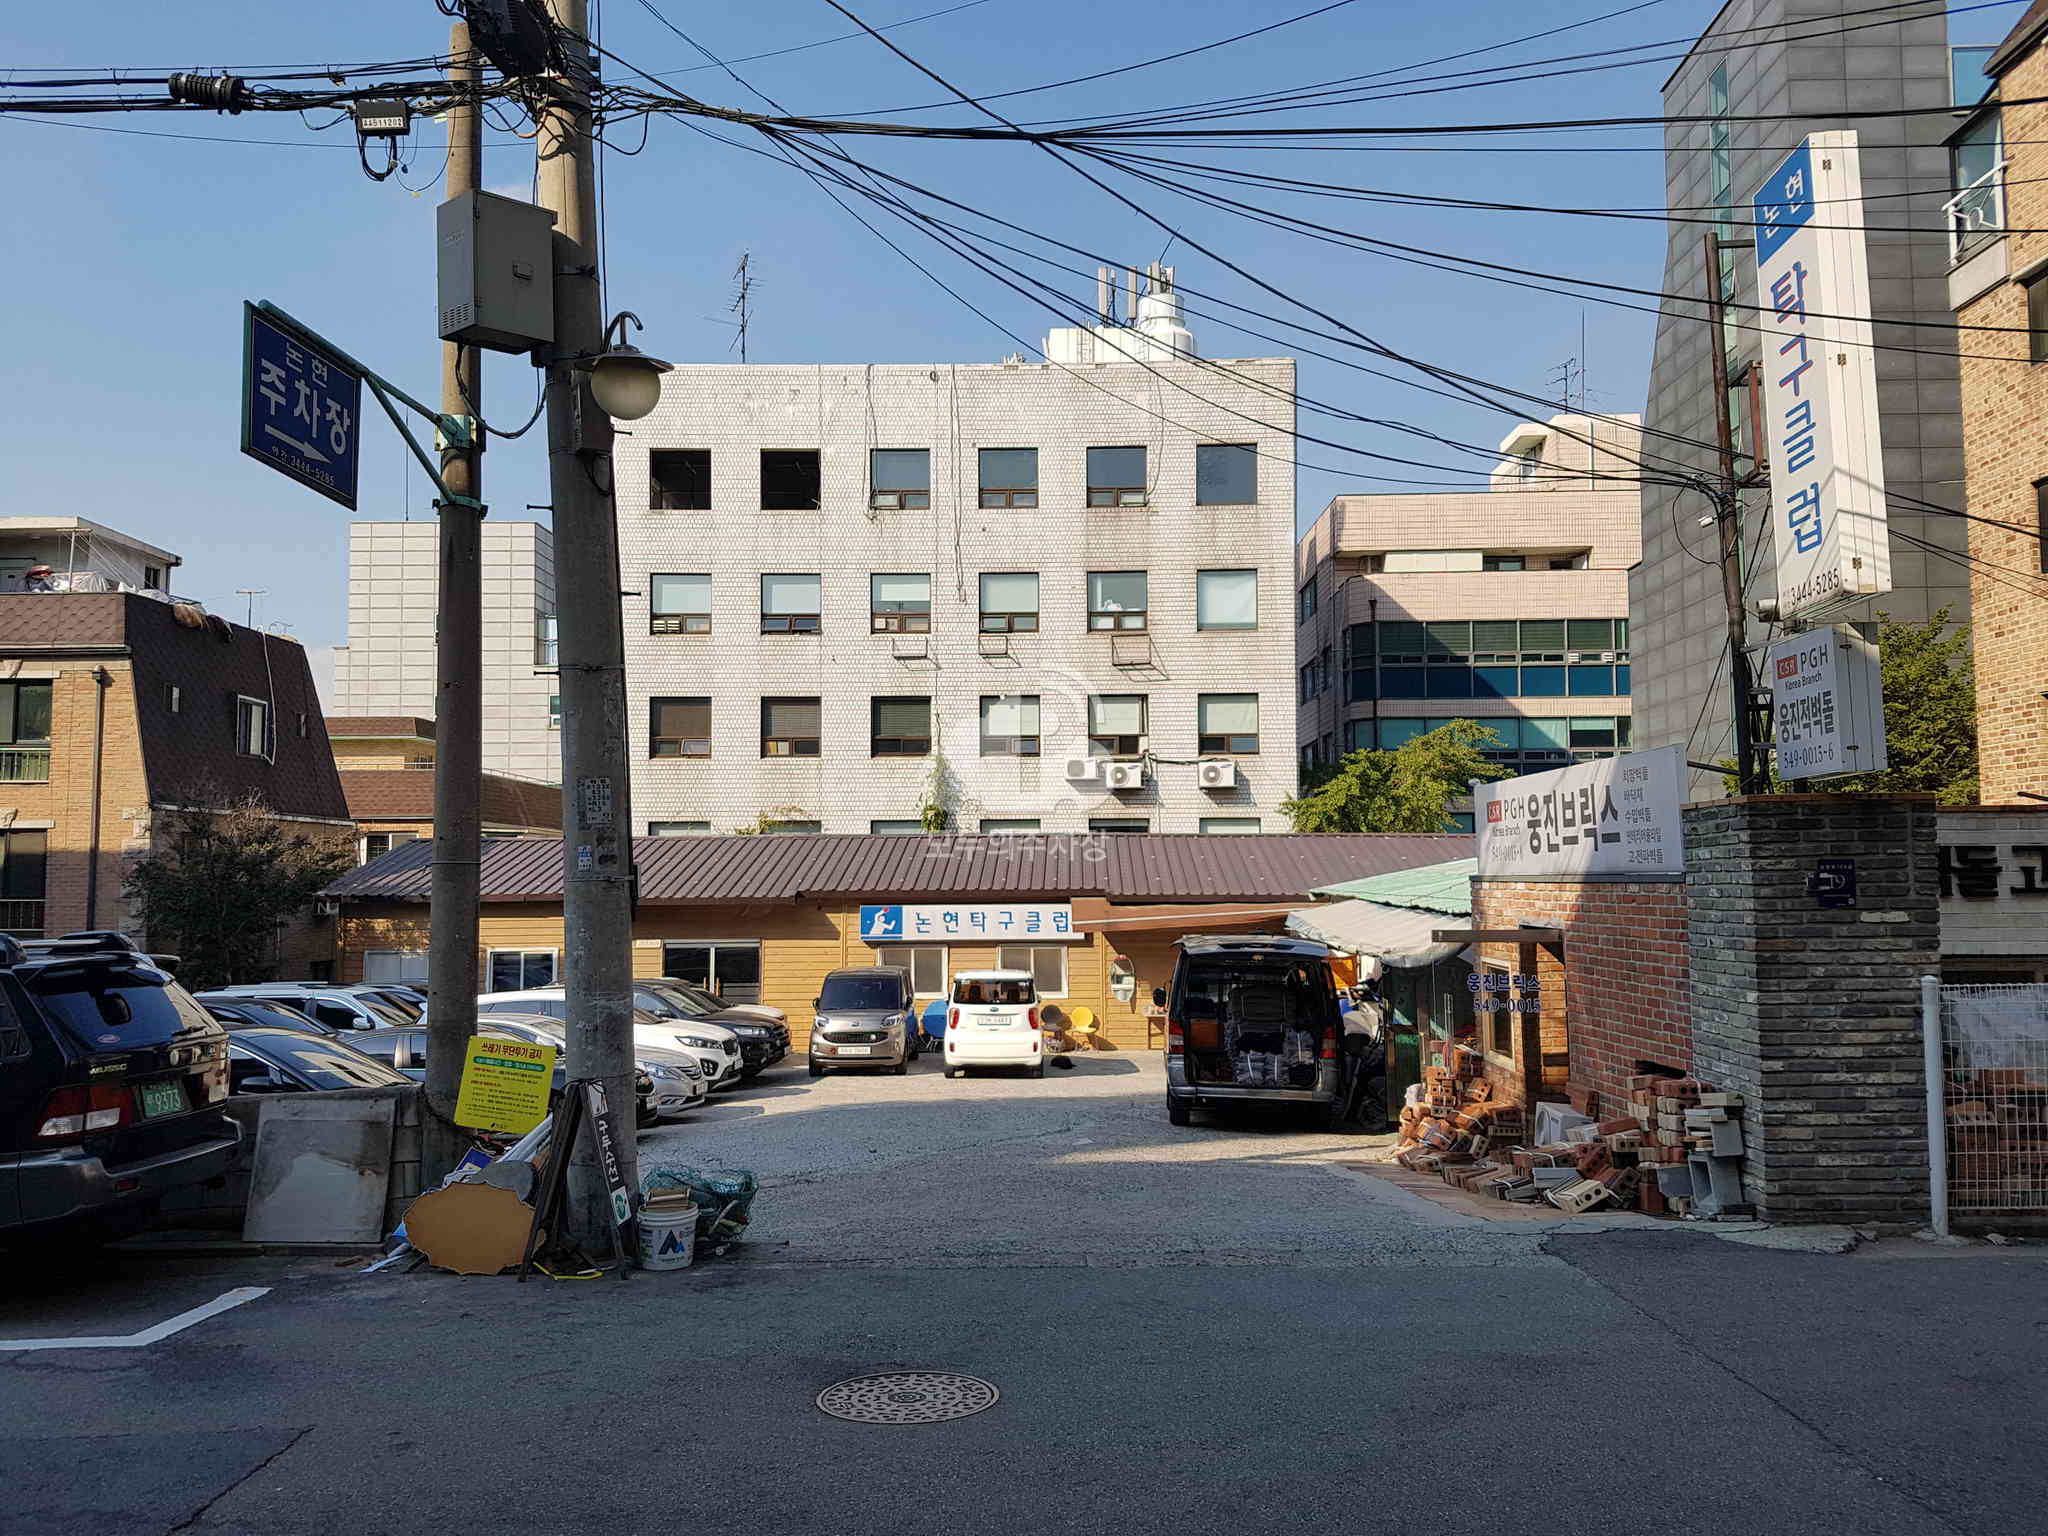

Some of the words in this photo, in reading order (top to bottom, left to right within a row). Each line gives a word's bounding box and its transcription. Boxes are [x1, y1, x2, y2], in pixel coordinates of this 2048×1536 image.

[1762, 167, 1804, 240] 논현
[286, 342, 329, 389] 논현
[259, 357, 351, 456] 주차장
[1770, 260, 1824, 554] 탁구클럽
[1791, 568, 1840, 606] 3444-5285
[1800, 643, 1829, 673] PGH
[1784, 677, 1802, 691] Korea
[1802, 671, 1823, 689] Branch
[1779, 690, 1834, 744] 웅진적벽돌
[1504, 793, 1525, 820] PGH
[1527, 783, 1621, 855] 웅진브릭스
[915, 911, 1069, 934] 논현탁구클럽
[1467, 973, 1541, 992] 웅진브릭스
[1473, 998, 1541, 1013] 549-0015
